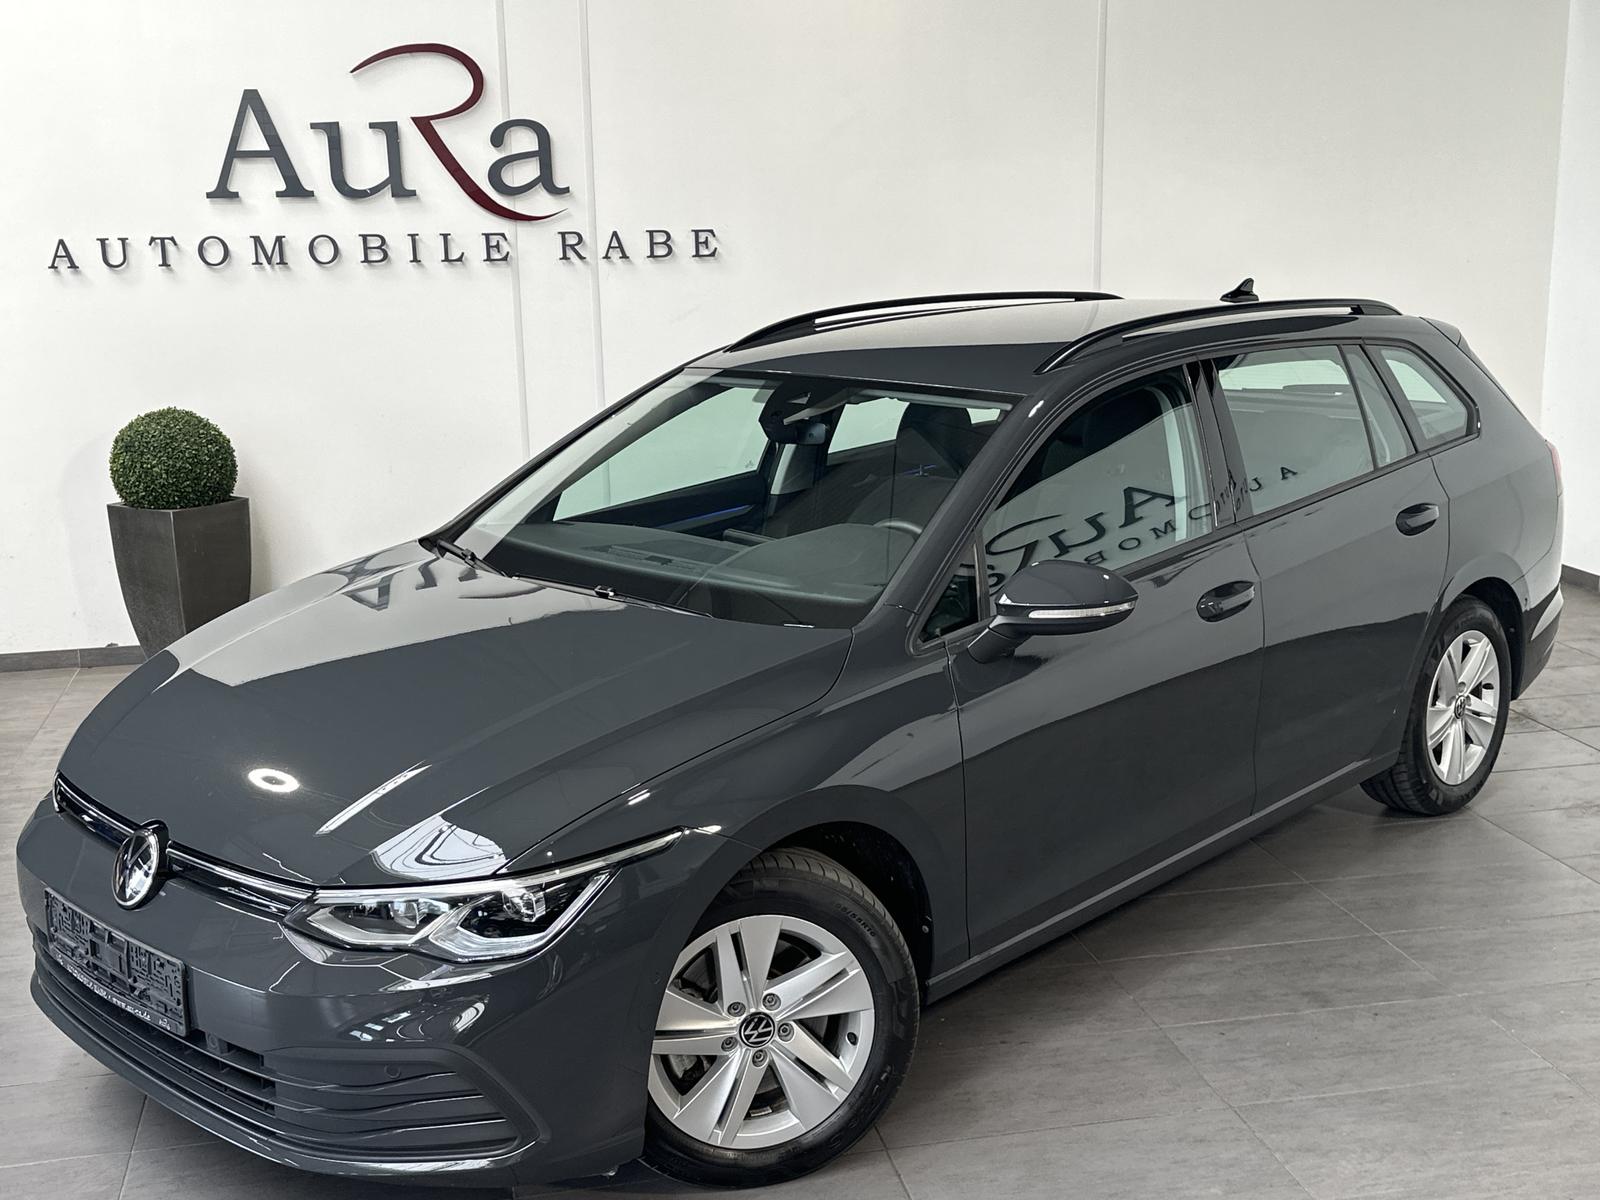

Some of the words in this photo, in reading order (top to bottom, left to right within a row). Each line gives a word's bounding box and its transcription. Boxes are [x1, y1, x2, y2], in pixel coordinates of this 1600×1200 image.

[205, 42, 571, 223] AuRa
[47, 231, 513, 271] AUTOMOBILE
[557, 227, 721, 264] RABE
